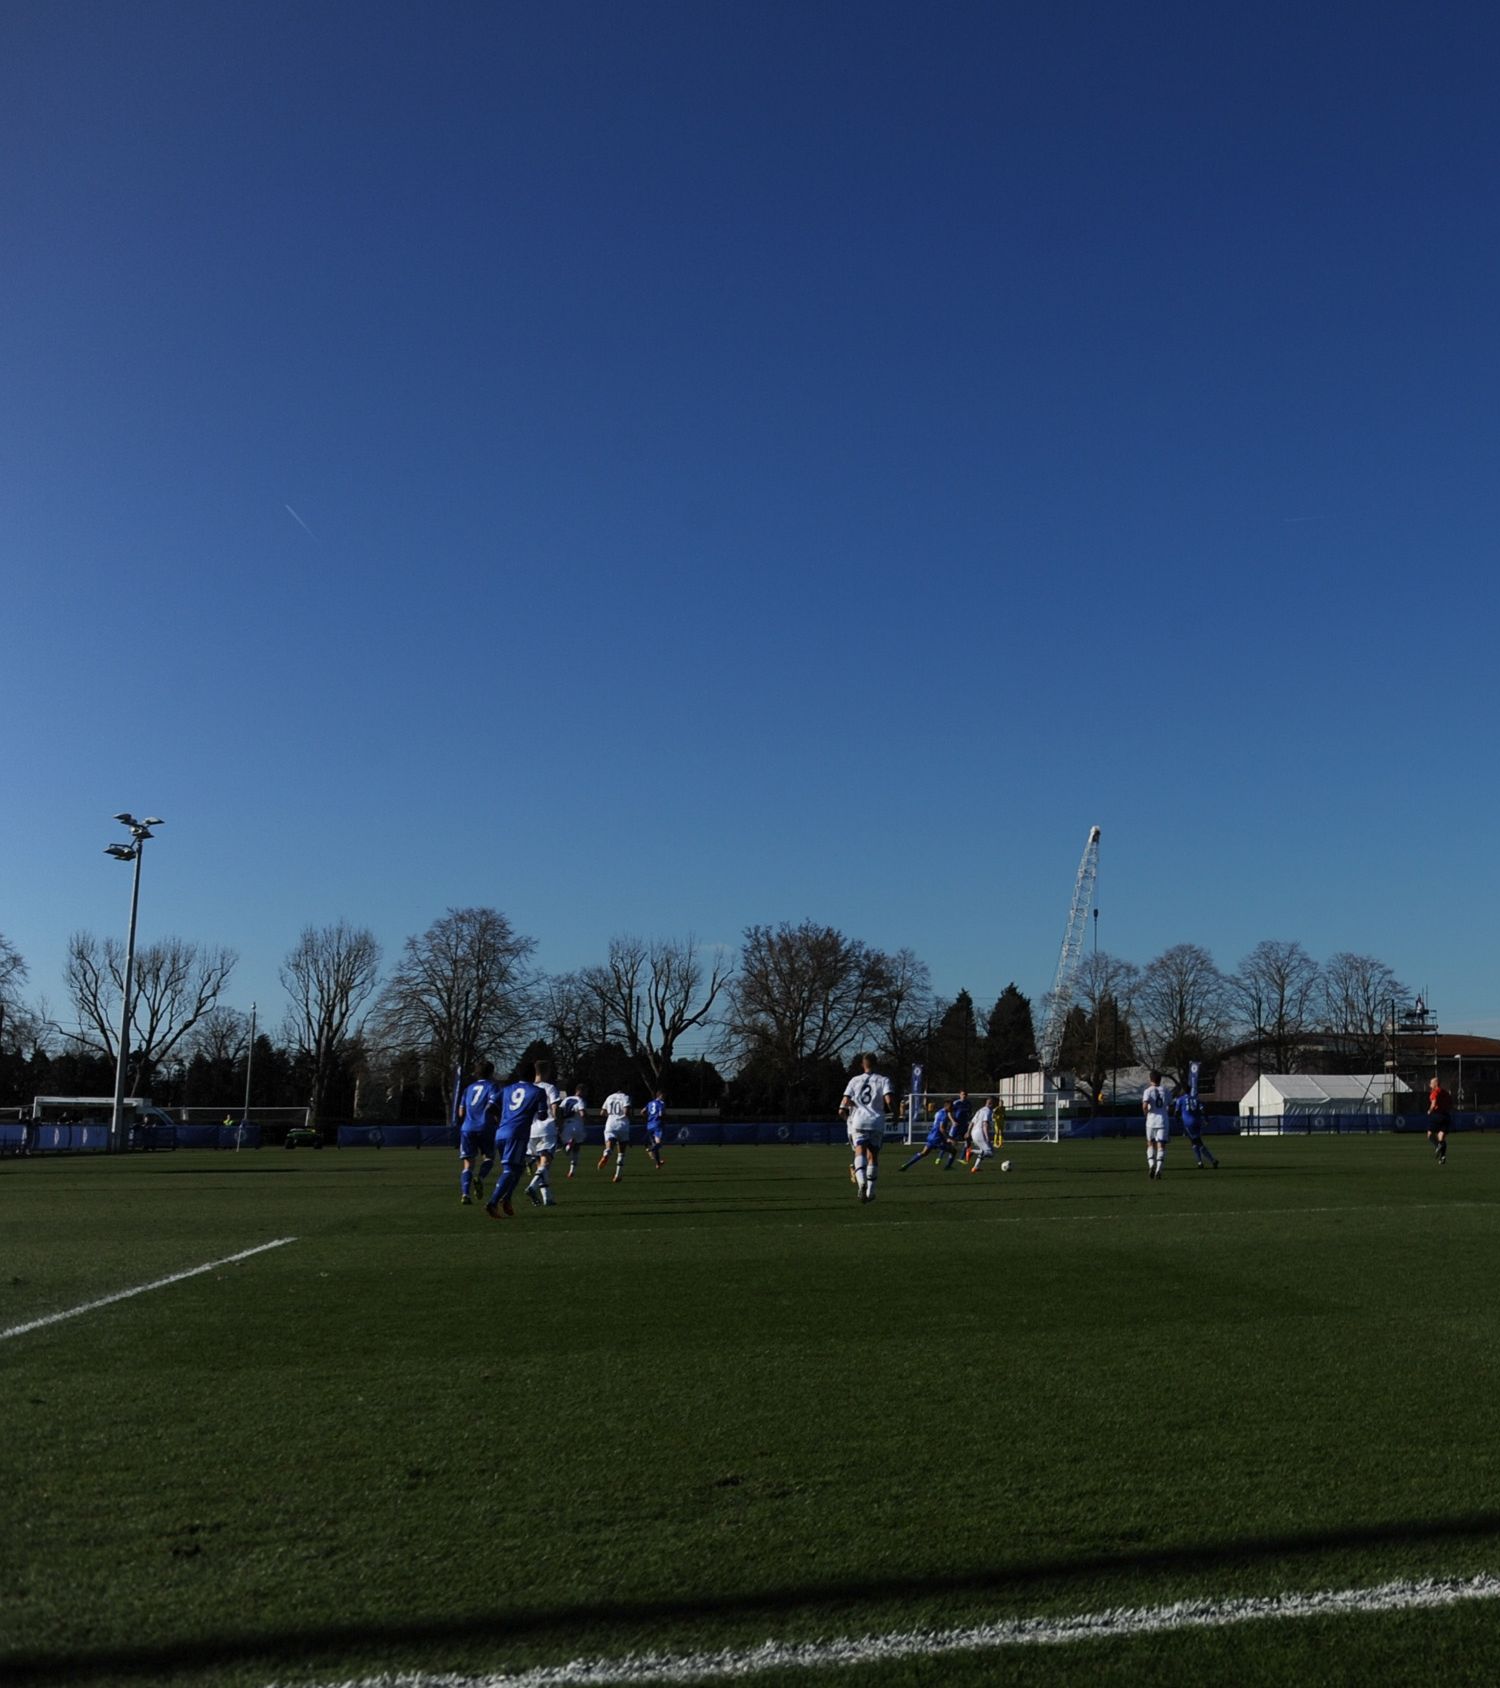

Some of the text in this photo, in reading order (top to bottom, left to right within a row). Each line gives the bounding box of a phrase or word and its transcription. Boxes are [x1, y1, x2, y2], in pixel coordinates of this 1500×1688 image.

[471, 1084, 483, 1106] 7
[510, 1088, 525, 1110] 9
[609, 1101, 623, 1115] 10
